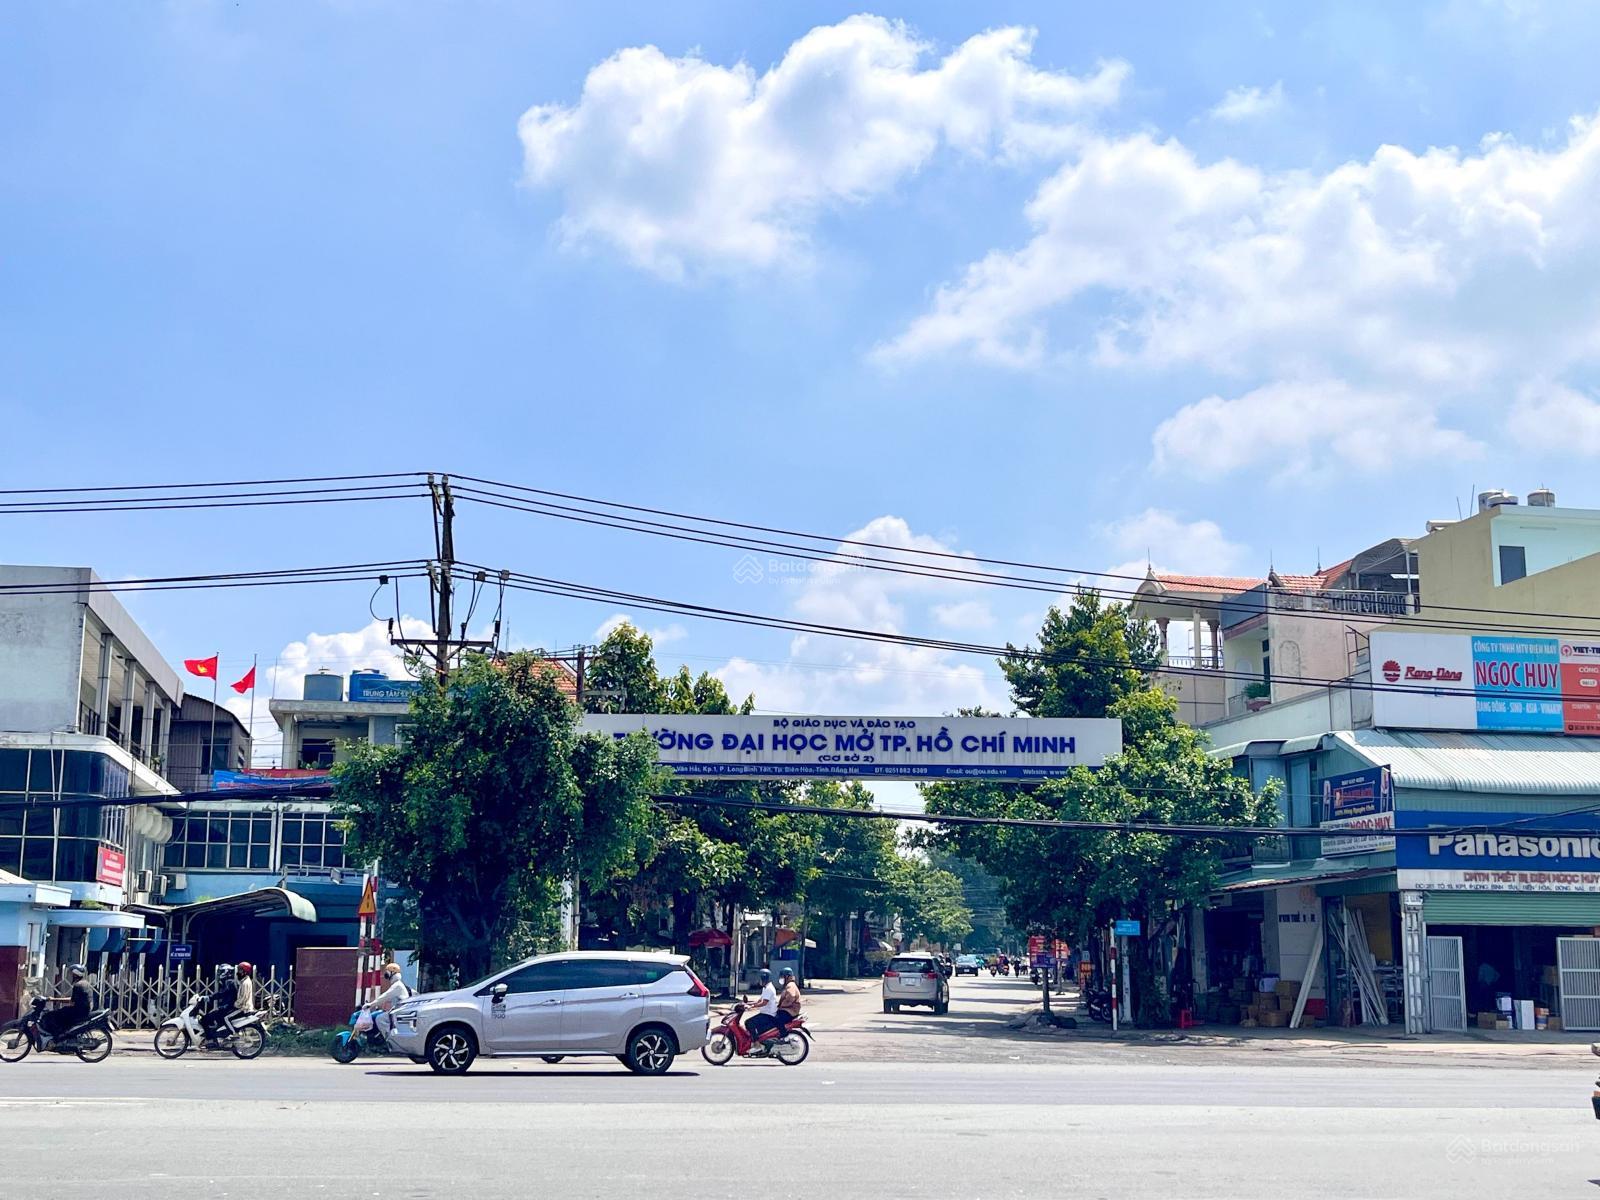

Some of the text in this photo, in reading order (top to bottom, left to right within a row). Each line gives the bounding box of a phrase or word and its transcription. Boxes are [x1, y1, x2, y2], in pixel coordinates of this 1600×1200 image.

[1524, 662, 1558, 688] HUY
[773, 717, 916, 730] BỘ GIÁO DỤC VÀ ĐÀO TẠO
[721, 733, 764, 754] ĐẠI
[772, 733, 827, 755] HỌC
[835, 728, 874, 751] MỞ
[880, 735, 911, 751] TP.
[917, 726, 953, 752] HỒ
[961, 731, 1006, 752] CHÍ
[1013, 736, 1075, 753] MINH
[863, 755, 875, 763] 2)
[1428, 834, 1600, 857] Panasonic
